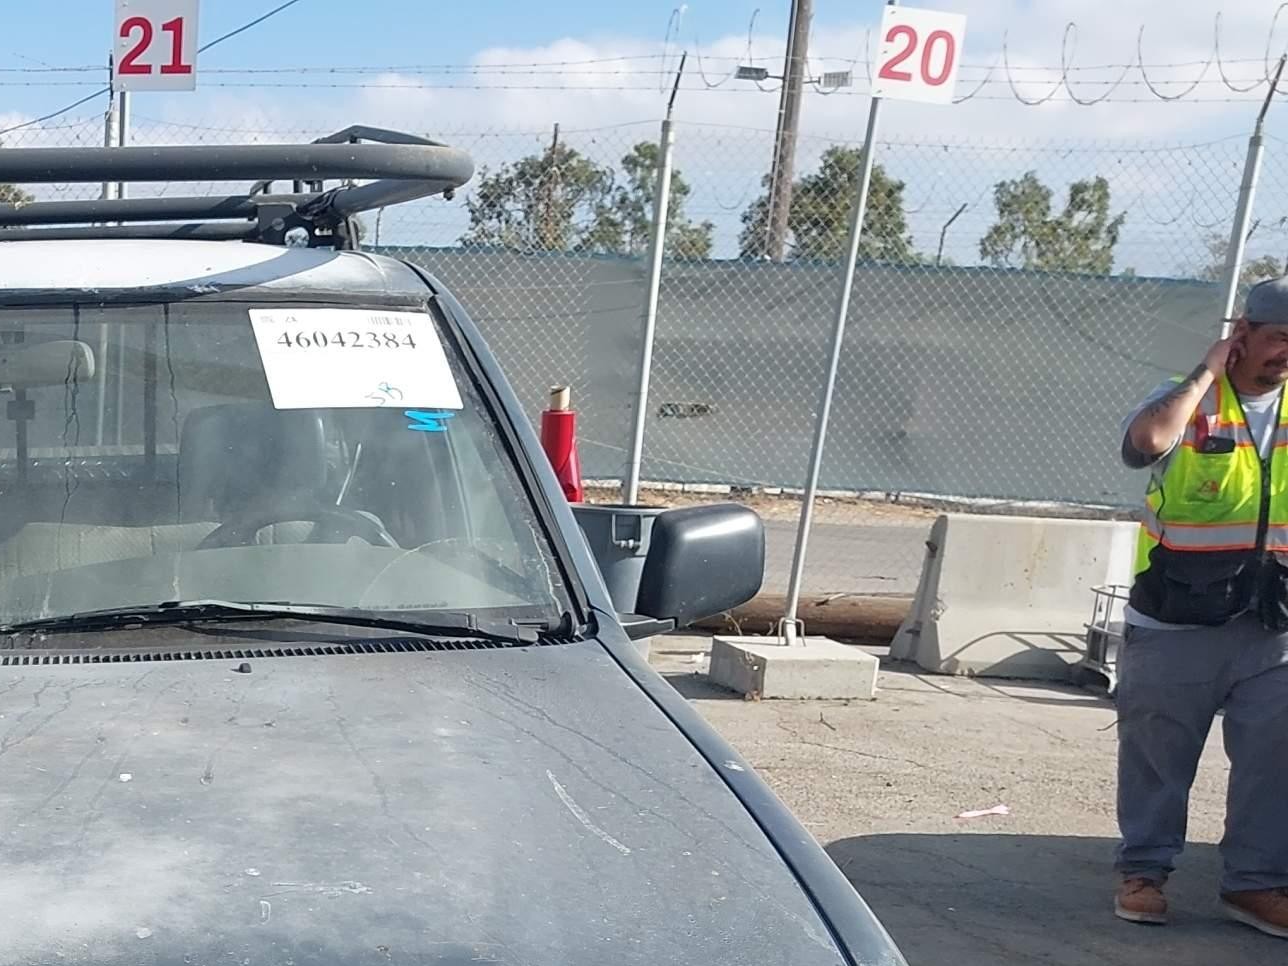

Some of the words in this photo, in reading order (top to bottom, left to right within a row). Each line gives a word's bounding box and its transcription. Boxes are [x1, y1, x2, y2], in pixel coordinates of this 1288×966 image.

[119, 17, 191, 75] 21
[879, 25, 955, 85] 20
[277, 331, 417, 350] 46042384
